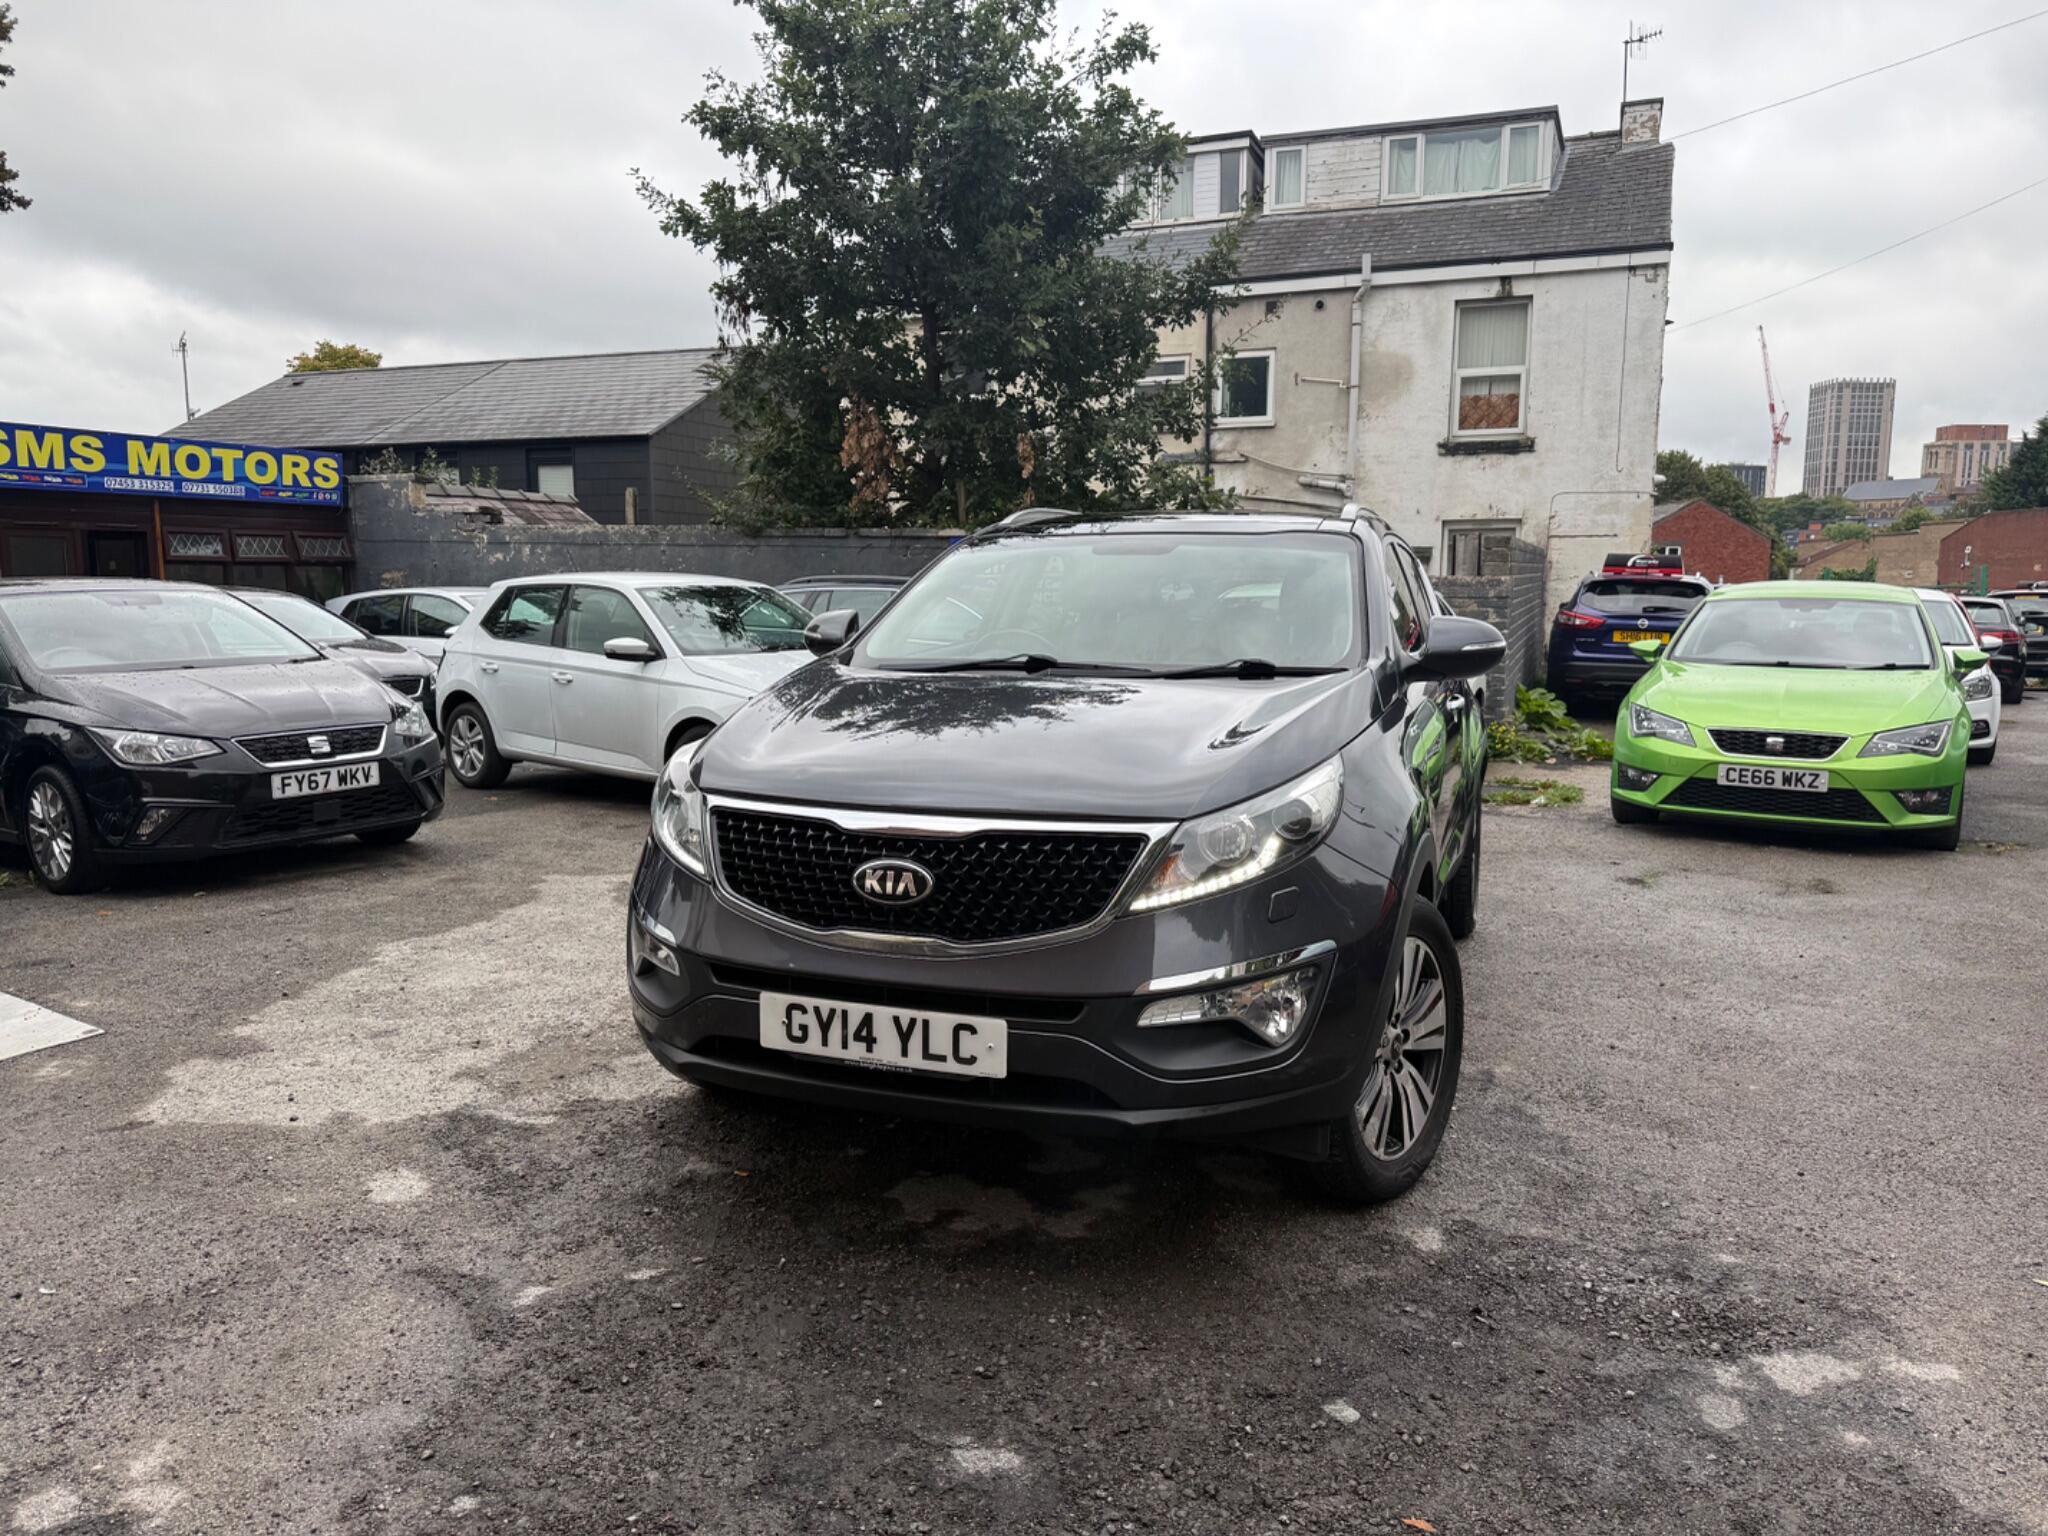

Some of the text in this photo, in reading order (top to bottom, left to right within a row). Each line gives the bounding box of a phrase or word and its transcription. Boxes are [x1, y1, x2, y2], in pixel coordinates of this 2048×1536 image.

[0, 429, 340, 489] MS MOTORS
[280, 765, 371, 794] FY67 WKV
[1725, 767, 1820, 789] CE66 WKZ
[864, 869, 917, 896] KIA
[785, 1003, 978, 1065] GY14 YLC
